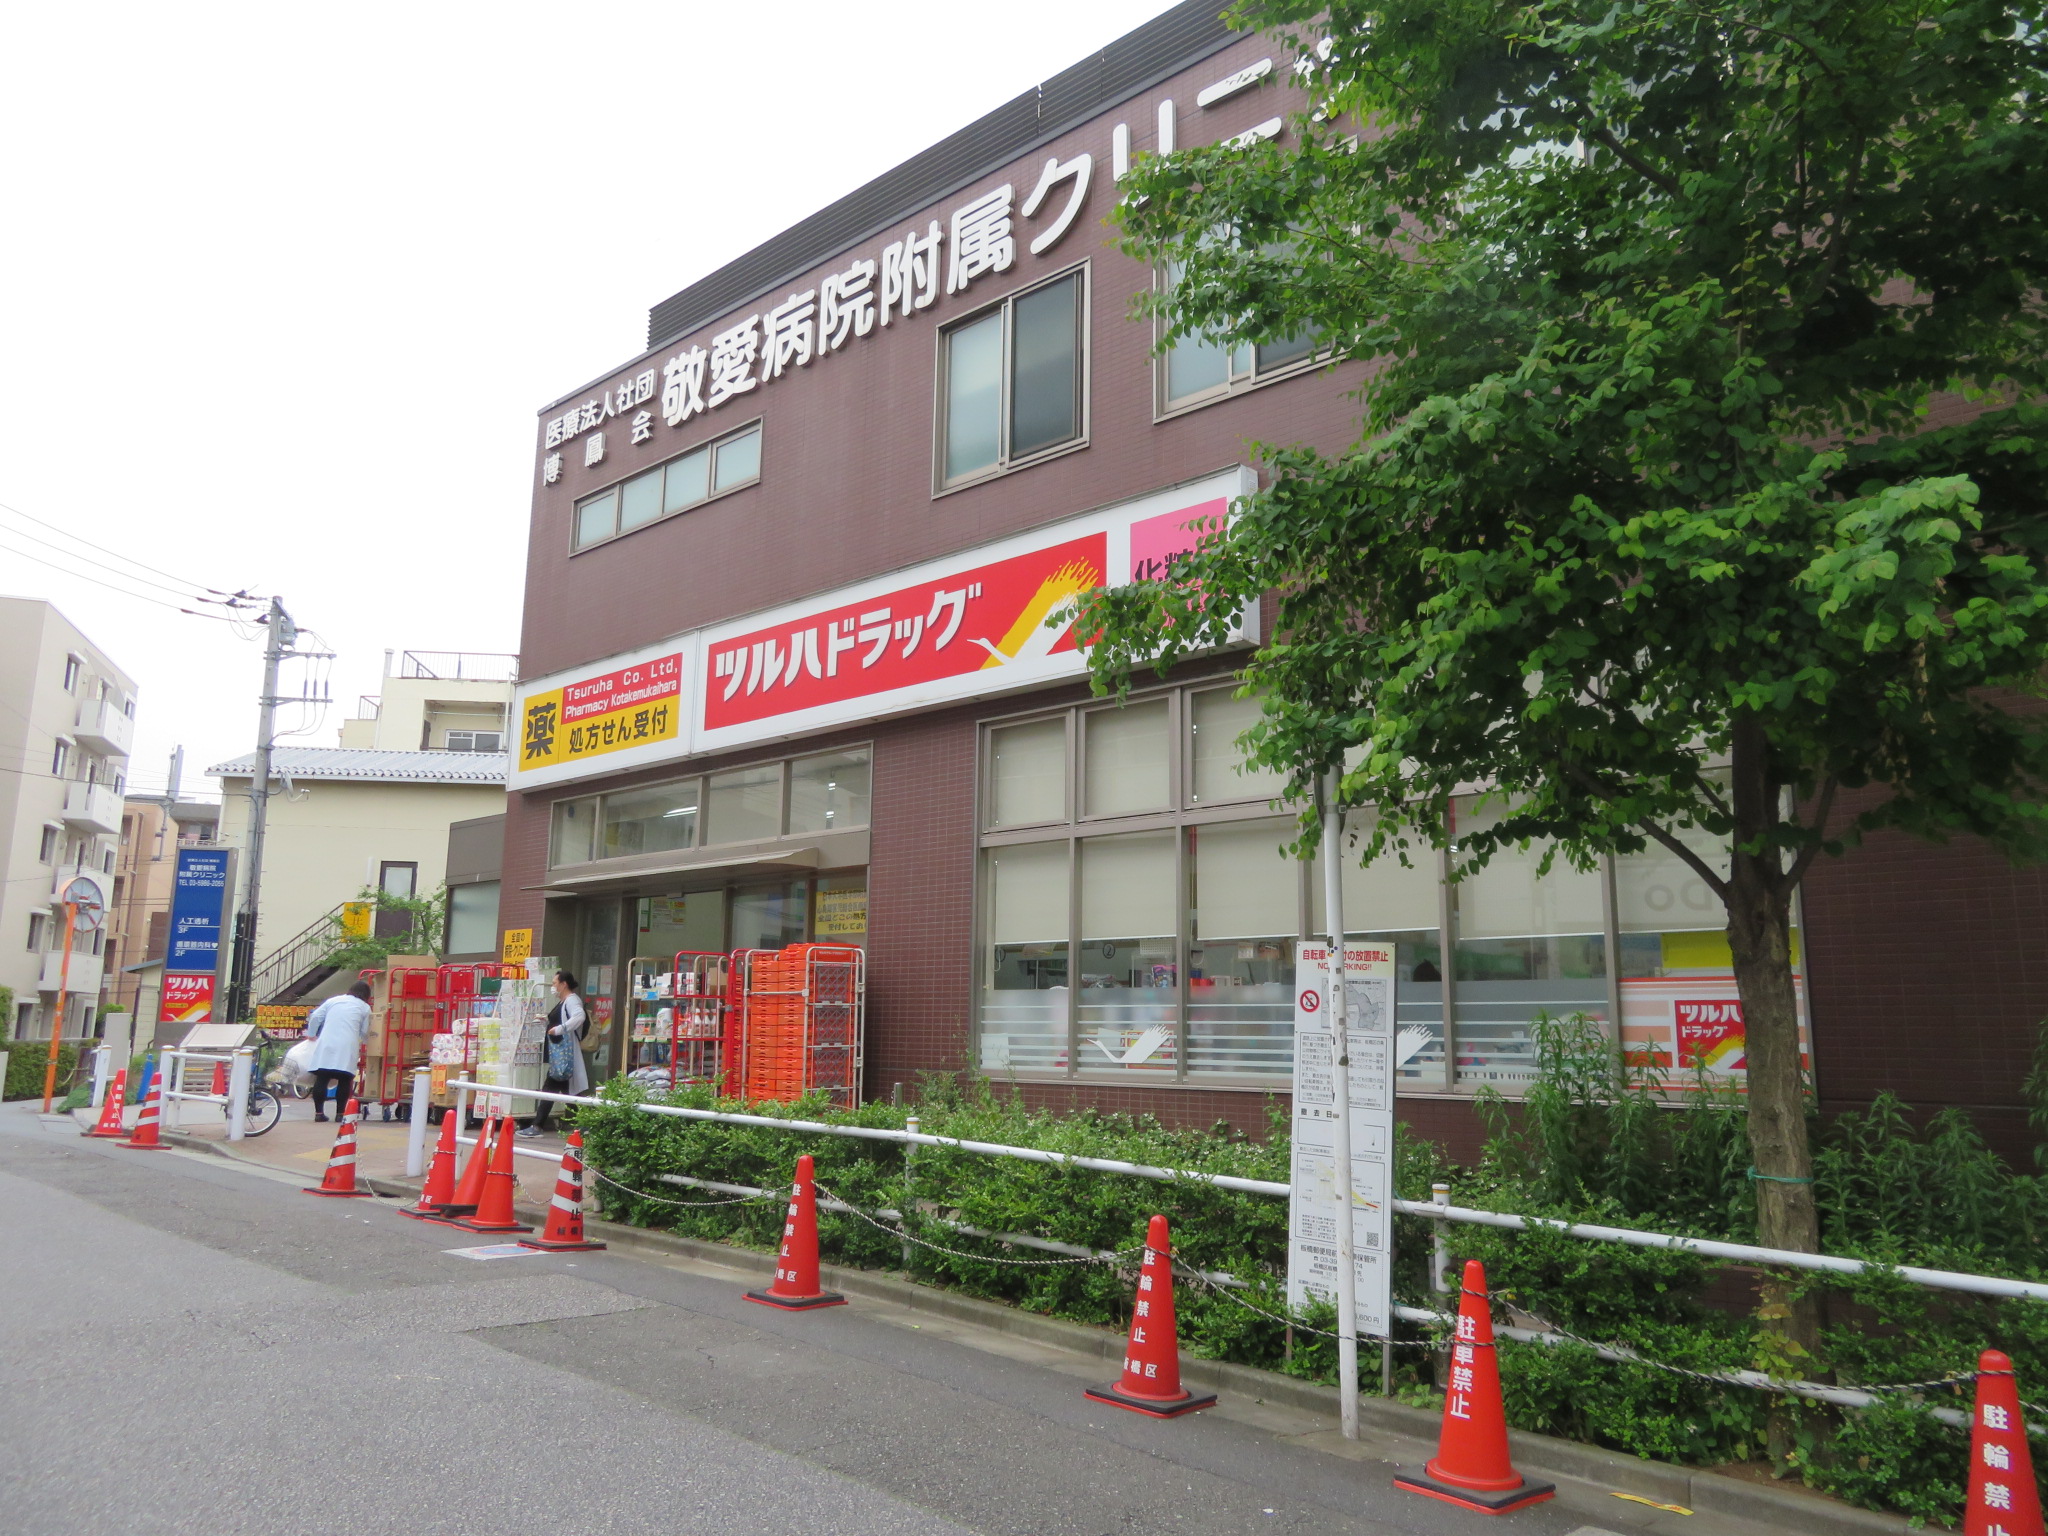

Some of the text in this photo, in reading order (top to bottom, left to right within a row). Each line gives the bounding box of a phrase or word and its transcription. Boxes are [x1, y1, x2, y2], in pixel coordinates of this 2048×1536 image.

[545, 368, 655, 450] 医療法人社団
[715, 582, 982, 702] ツルハドラッグ
[565, 679, 677, 719] Pharmacy Kotakemukaihara
[567, 679, 613, 701] Tsuruha
[623, 671, 644, 686] Co.
[525, 702, 557, 760] 薬
[569, 704, 668, 754] 処方せん受付
[178, 926, 189, 934] 3F
[166, 991, 200, 1000] ドラッグ
[168, 977, 209, 990] ツルハ
[1680, 1004, 1741, 1023] ツルハ
[1681, 1025, 1728, 1038] ドラッグ
[1133, 1248, 1156, 1344] 駐輪禁止
[1450, 1314, 1476, 1420] 駐車禁止
